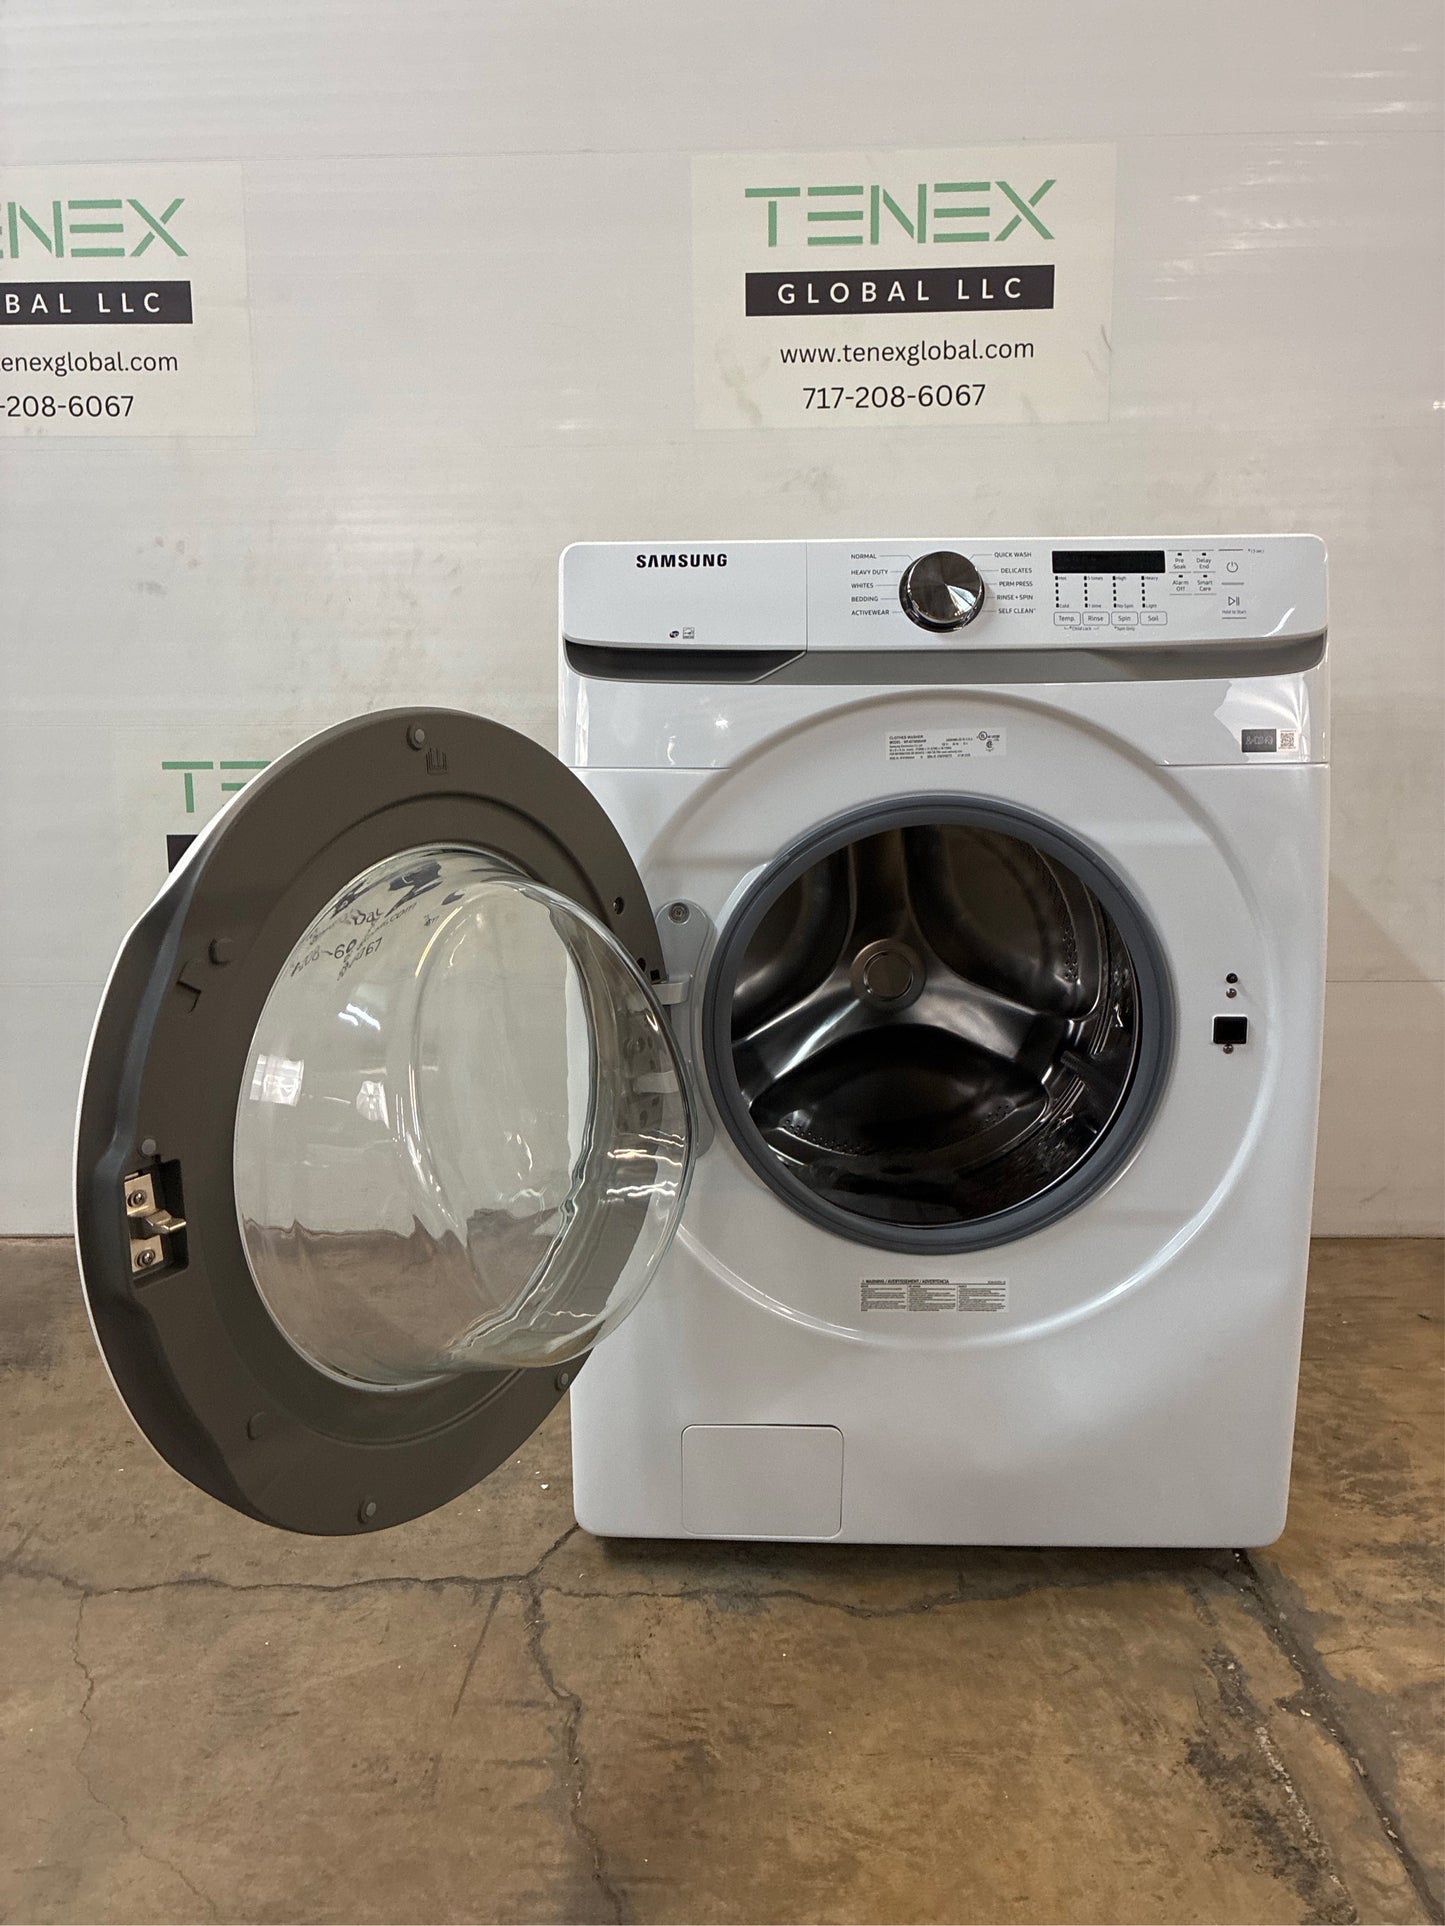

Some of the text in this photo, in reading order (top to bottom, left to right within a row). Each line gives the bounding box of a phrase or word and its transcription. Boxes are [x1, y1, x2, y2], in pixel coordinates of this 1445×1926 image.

[745, 179, 1057, 247] TENEX
[0, 198, 189, 259] NEX
[98, 292, 160, 313] LLC
[777, 277, 1021, 305] GLOBAL LLC
[0, 351, 178, 377] enexglobal.com
[780, 339, 1034, 367] www.tenexglobal.com
[802, 384, 986, 410] 717-208-6067
[636, 553, 728, 568] SAMSUNG
[1118, 615, 1131, 623] Spin
